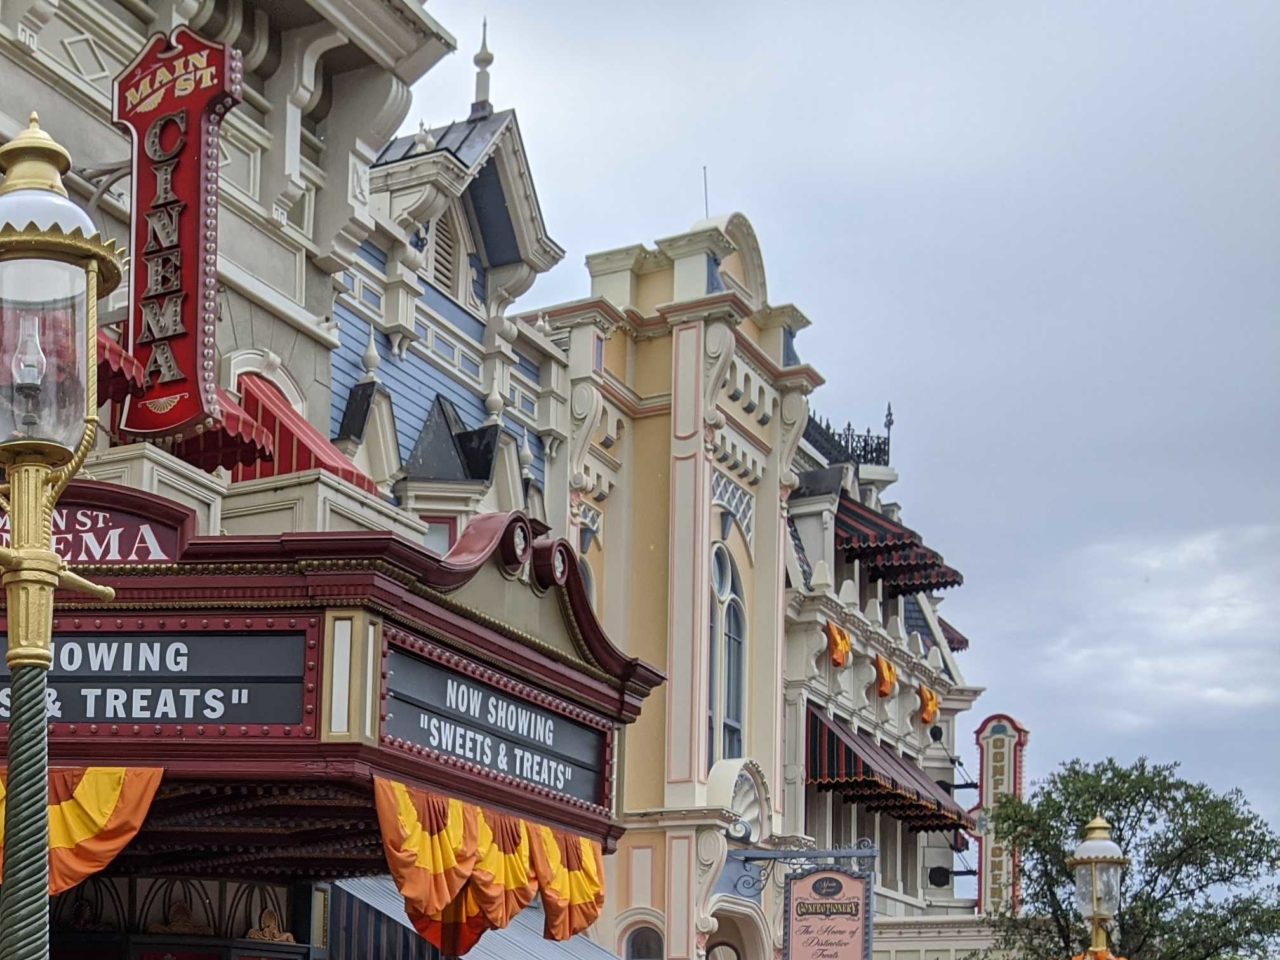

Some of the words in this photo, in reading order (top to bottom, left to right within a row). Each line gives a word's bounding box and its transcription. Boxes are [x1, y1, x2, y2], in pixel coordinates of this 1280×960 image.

[125, 49, 210, 112] MAIN
[174, 66, 218, 98] ST.
[136, 107, 188, 391] CINEMA
[75, 510, 113, 530] ST.
[49, 641, 189, 672] OWING
[81, 688, 248, 719] TREATS"
[446, 679, 483, 718] NOW
[487, 696, 554, 746] SHOWING
[420, 713, 492, 765] "SWEETS
[497, 742, 508, 771] &
[514, 747, 572, 790] TREATS"
[795, 925, 813, 936] The
[817, 925, 846, 936] Home
[849, 927, 859, 938] of
[802, 936, 850, 947] Distinctive
[811, 948, 839, 959] Treats
